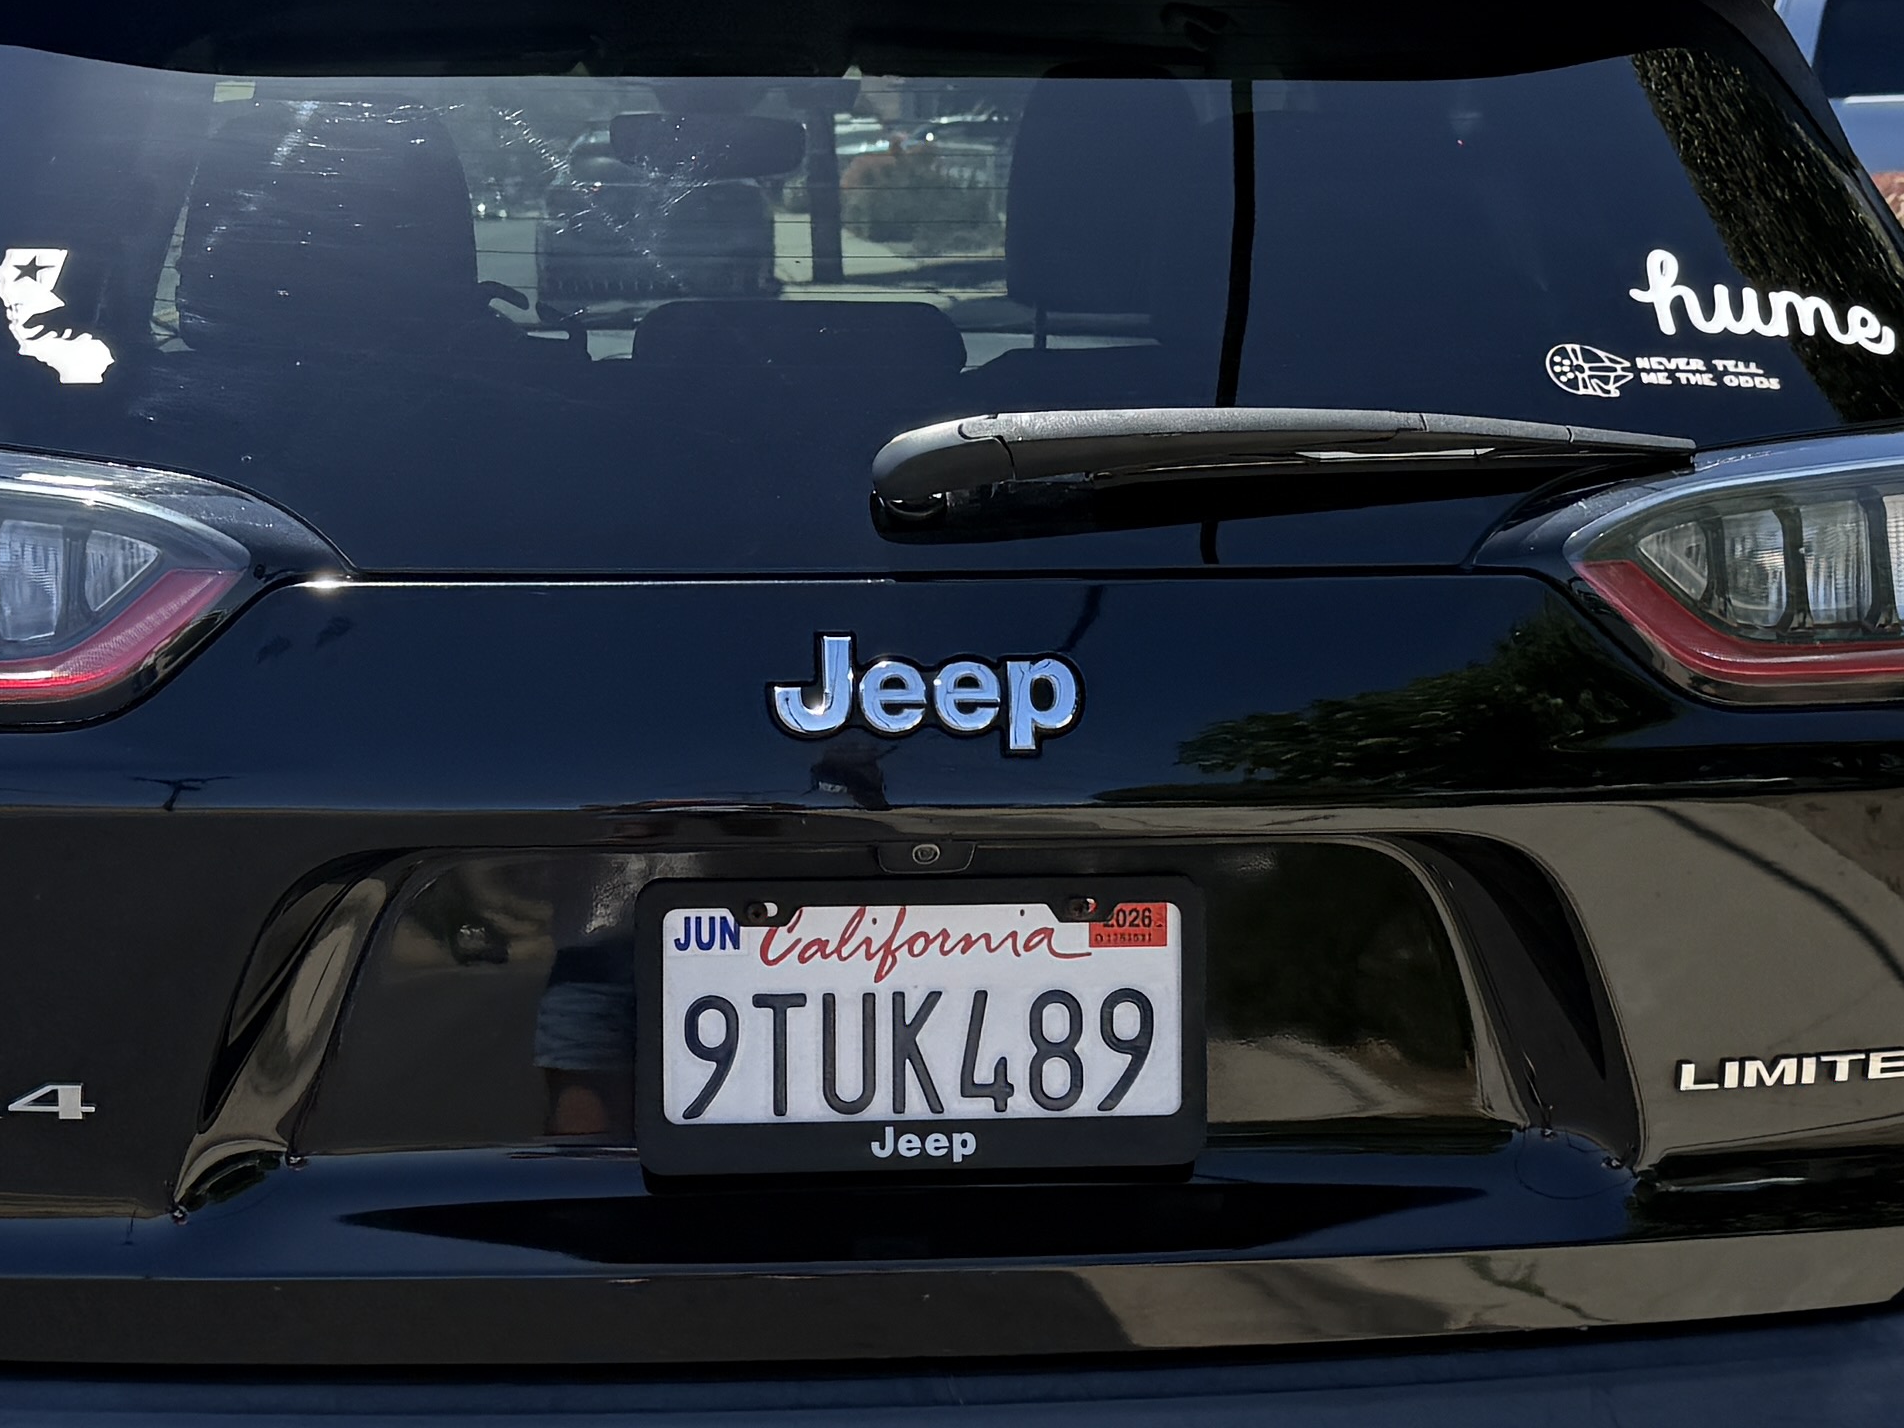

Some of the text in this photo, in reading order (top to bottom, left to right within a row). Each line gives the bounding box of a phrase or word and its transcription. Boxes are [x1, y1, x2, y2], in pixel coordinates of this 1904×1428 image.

[1629, 249, 1896, 355] hume
[1635, 356, 1764, 374] NEVER TELL
[1640, 372, 1781, 390] ME THE ODDS
[771, 634, 1081, 751] Jeep
[673, 915, 741, 951] JUN
[759, 906, 1092, 984] California
[682, 987, 1155, 1120] 9TUK489
[870, 1126, 977, 1163] Jeep
